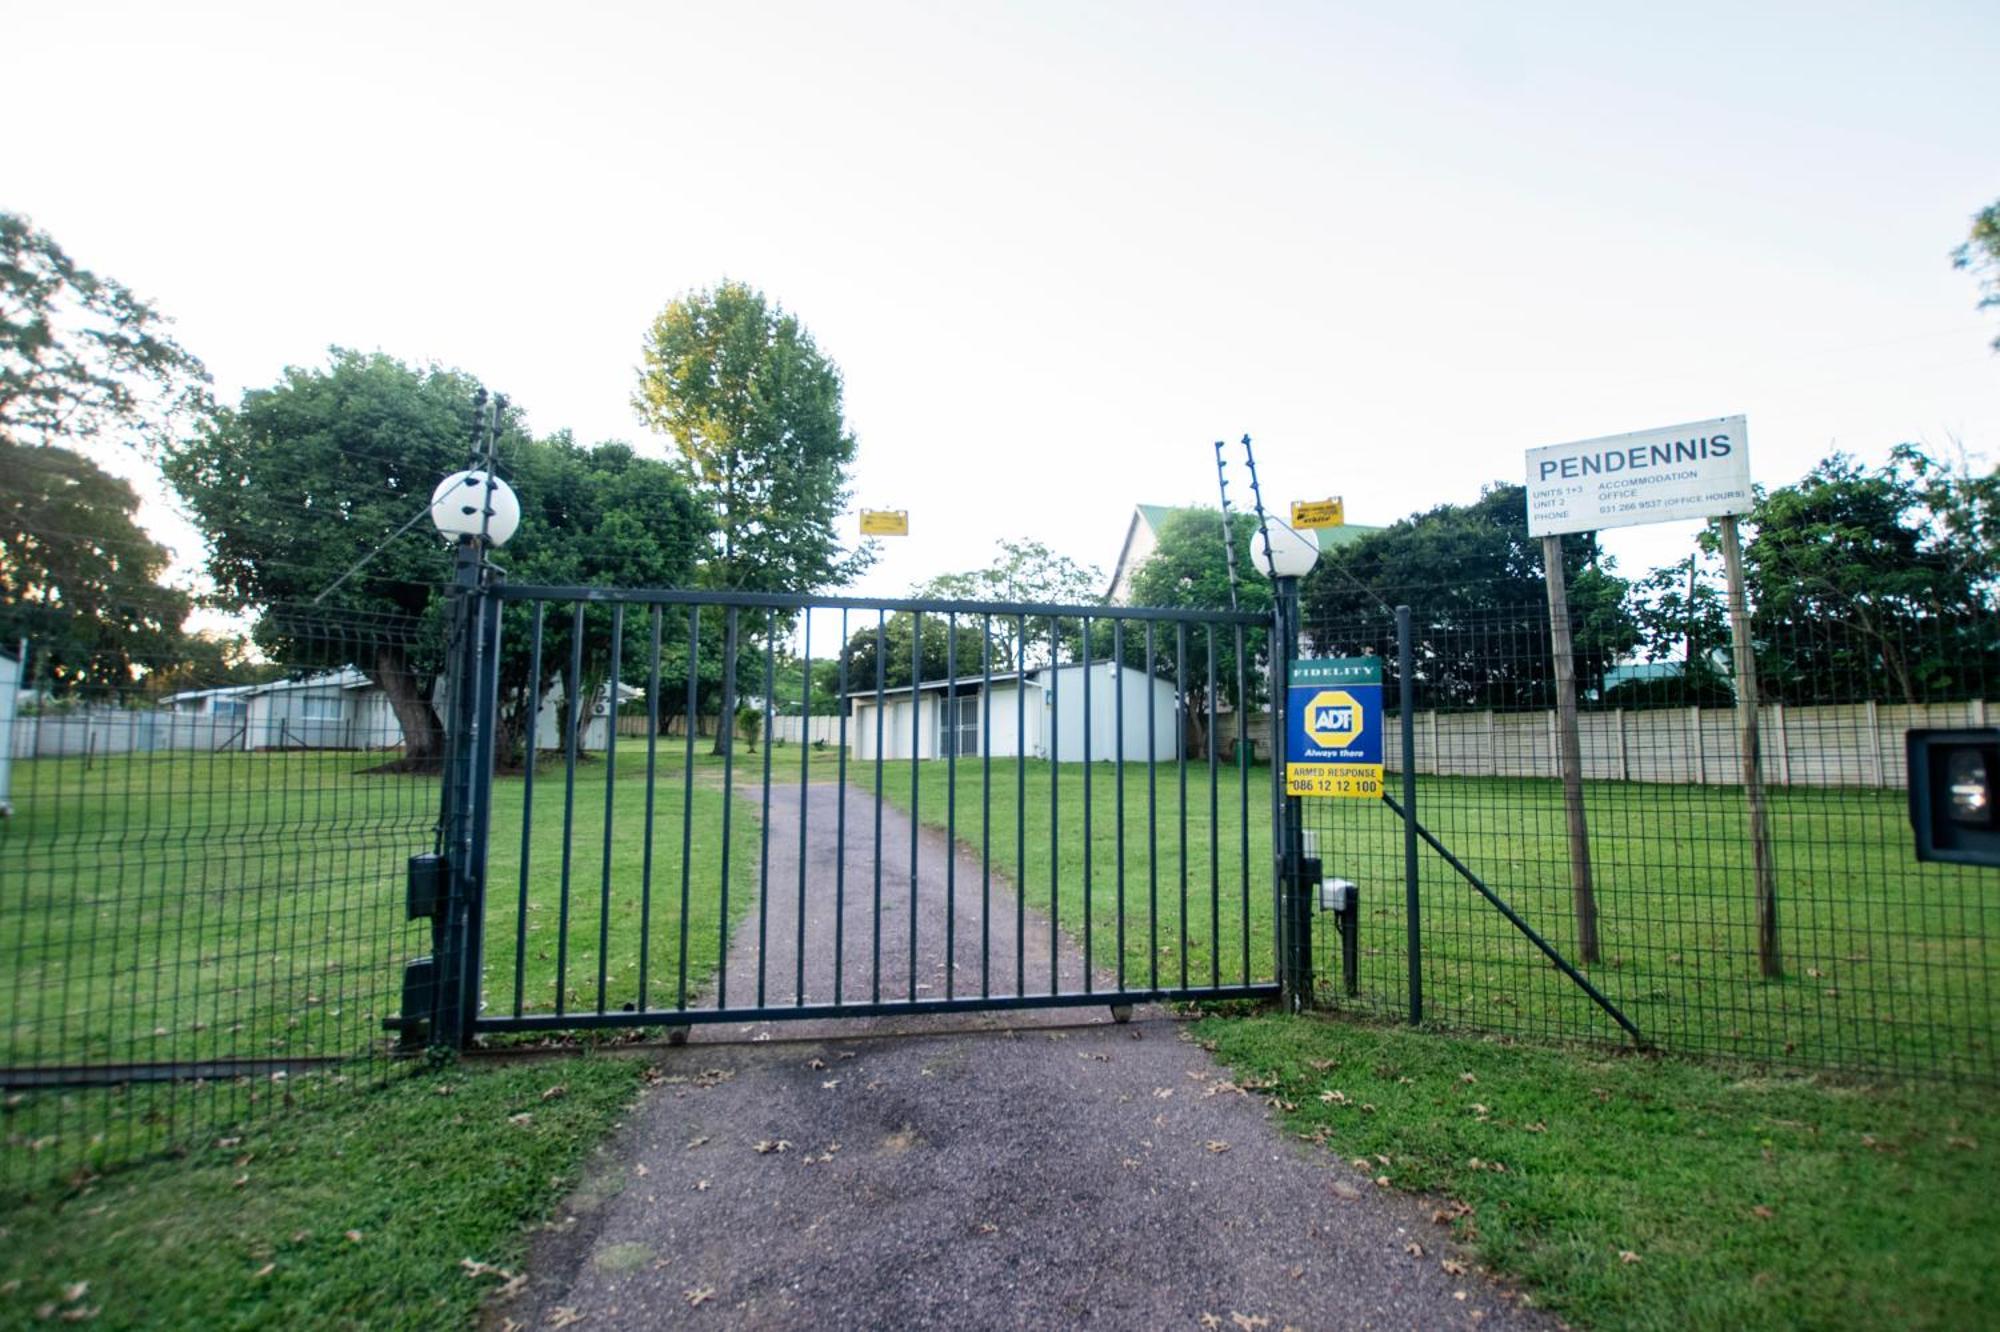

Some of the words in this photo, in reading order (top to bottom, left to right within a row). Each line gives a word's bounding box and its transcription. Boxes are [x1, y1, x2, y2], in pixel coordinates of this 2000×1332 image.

[1540, 434, 1731, 481] PENDENNIS
[1533, 488, 1563, 499] UNITS
[1598, 471, 1698, 490] ACCOMMODATION
[1534, 499, 1556, 509] UNIT
[1598, 489, 1636, 501] OFFICE
[1534, 511, 1569, 521] PHONE
[1600, 504, 1616, 514] 031
[1639, 499, 1662, 509] 9537
[1664, 495, 1701, 508] (OFFICE
[1705, 490, 1745, 501] HOURS)
[1293, 666, 1374, 678] FIDELITY
[1315, 709, 1352, 729] ADT
[1304, 749, 1338, 758] Always
[1340, 749, 1364, 758] there
[1294, 767, 1325, 777] ARMED
[1328, 768, 1376, 778] RESPONSE
[1293, 780, 1313, 791] 086
[1318, 780, 1331, 791] 12
[1337, 781, 1350, 792] 12
[1356, 781, 1377, 792] 100
